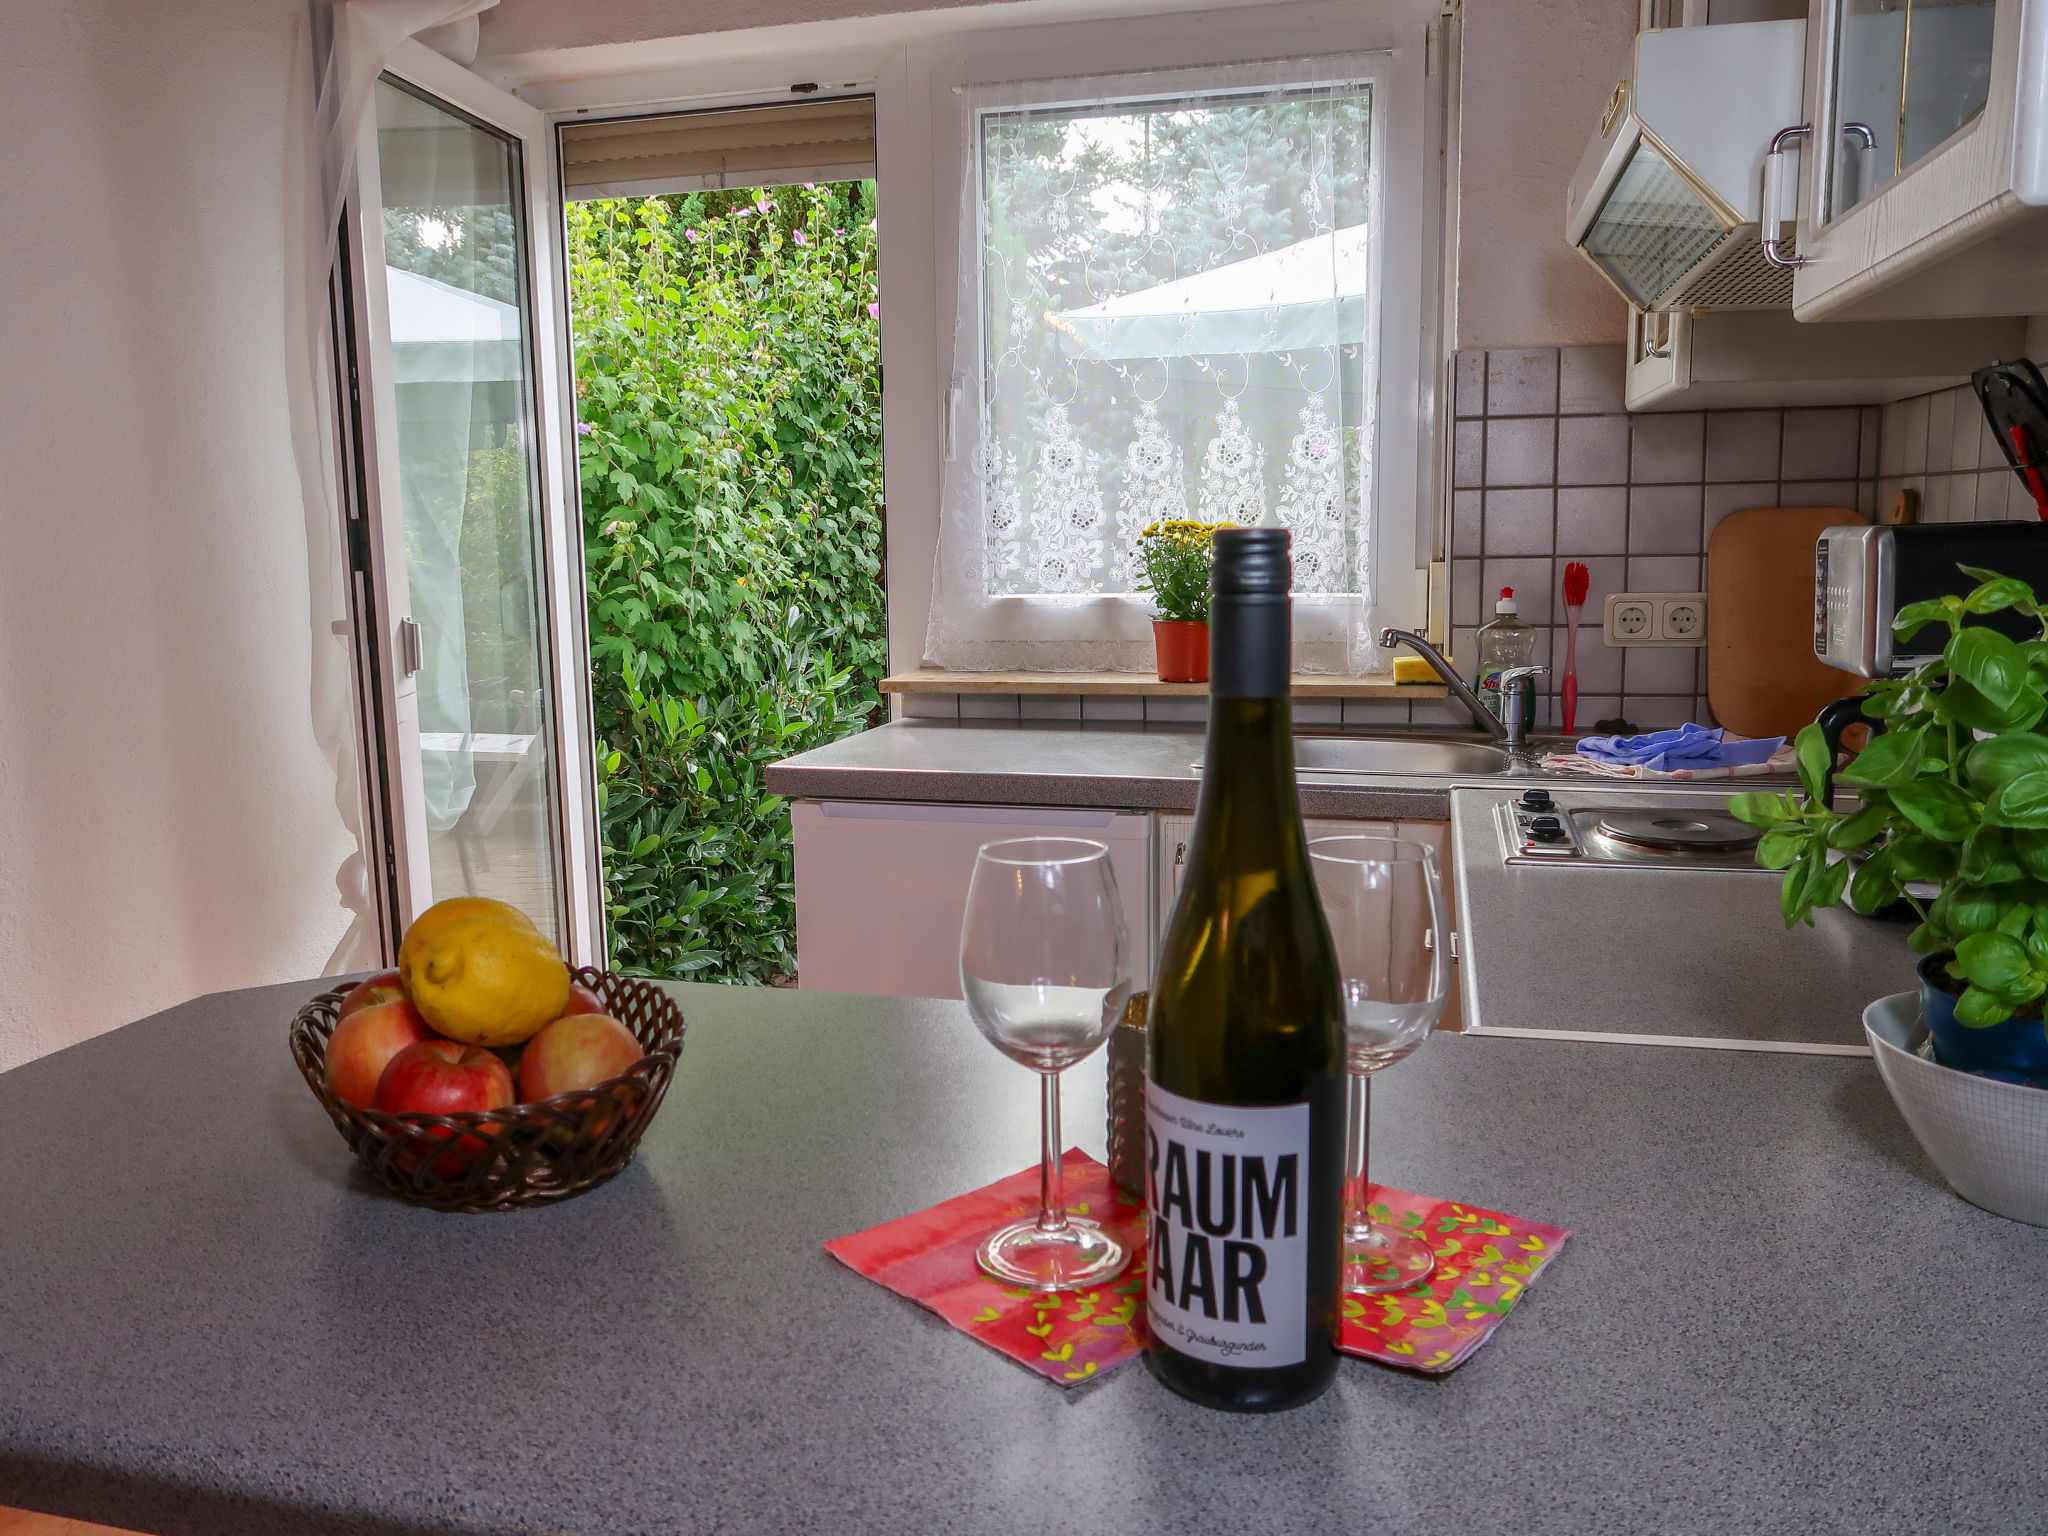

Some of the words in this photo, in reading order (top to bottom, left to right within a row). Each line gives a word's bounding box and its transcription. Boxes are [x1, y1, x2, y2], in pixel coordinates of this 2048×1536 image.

[1180, 1117, 1203, 1132] Wine
[1205, 1122, 1245, 1139] Lovers
[1148, 1214, 1267, 1325] AAR
